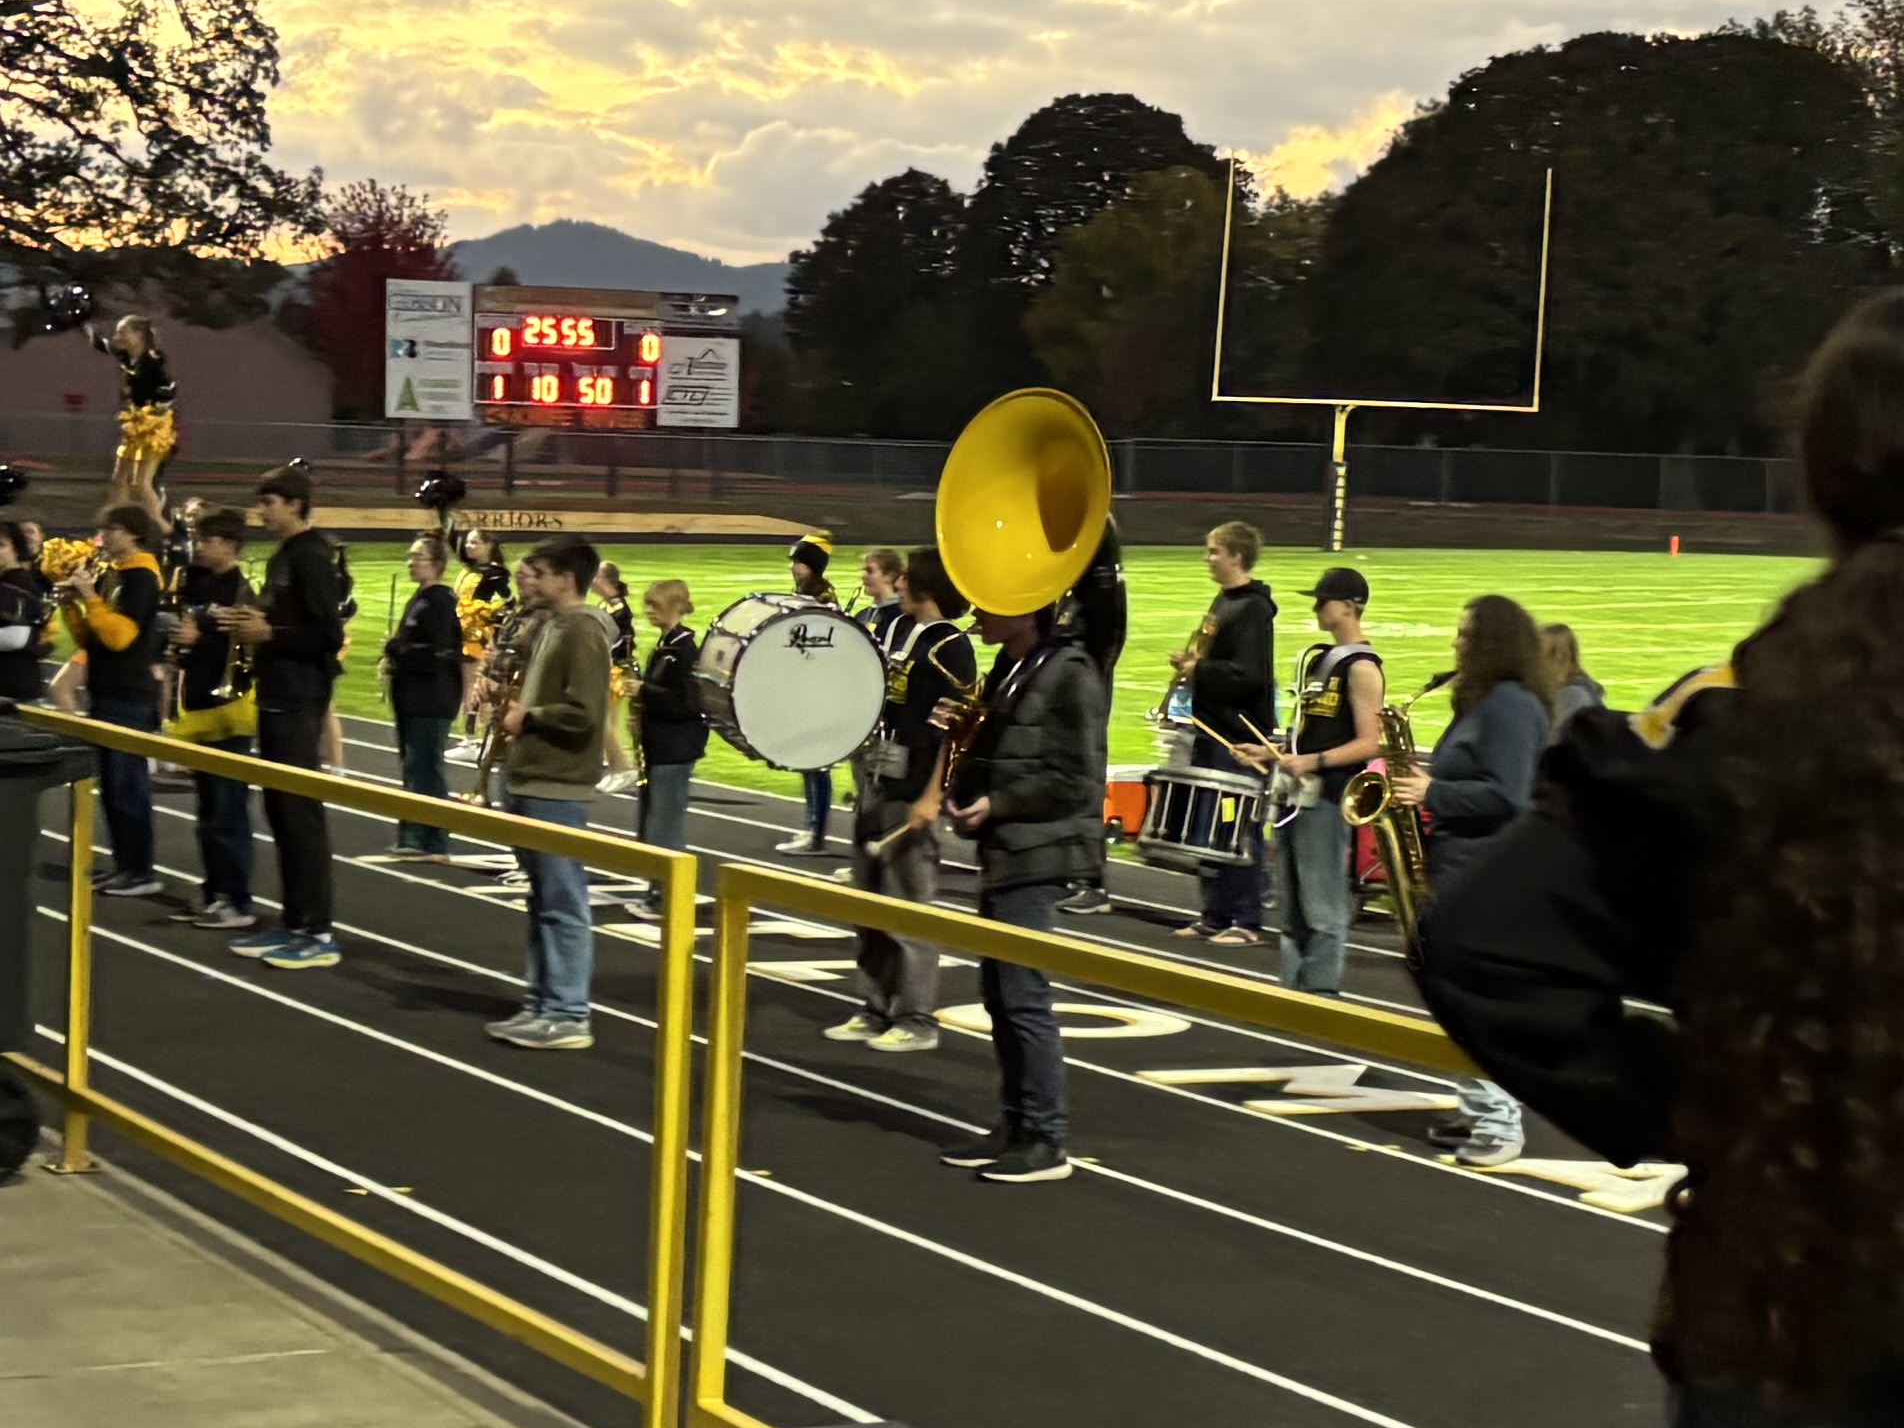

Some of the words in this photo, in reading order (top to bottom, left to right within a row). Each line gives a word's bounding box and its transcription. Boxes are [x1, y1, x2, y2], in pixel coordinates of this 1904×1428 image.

[491, 327, 512, 357] 0
[641, 333, 662, 363] 0
[494, 375, 504, 401] 1
[531, 375, 559, 403] 10
[578, 376, 613, 405] 50
[640, 379, 650, 405] 1
[451, 510, 563, 531] ARRIORS
